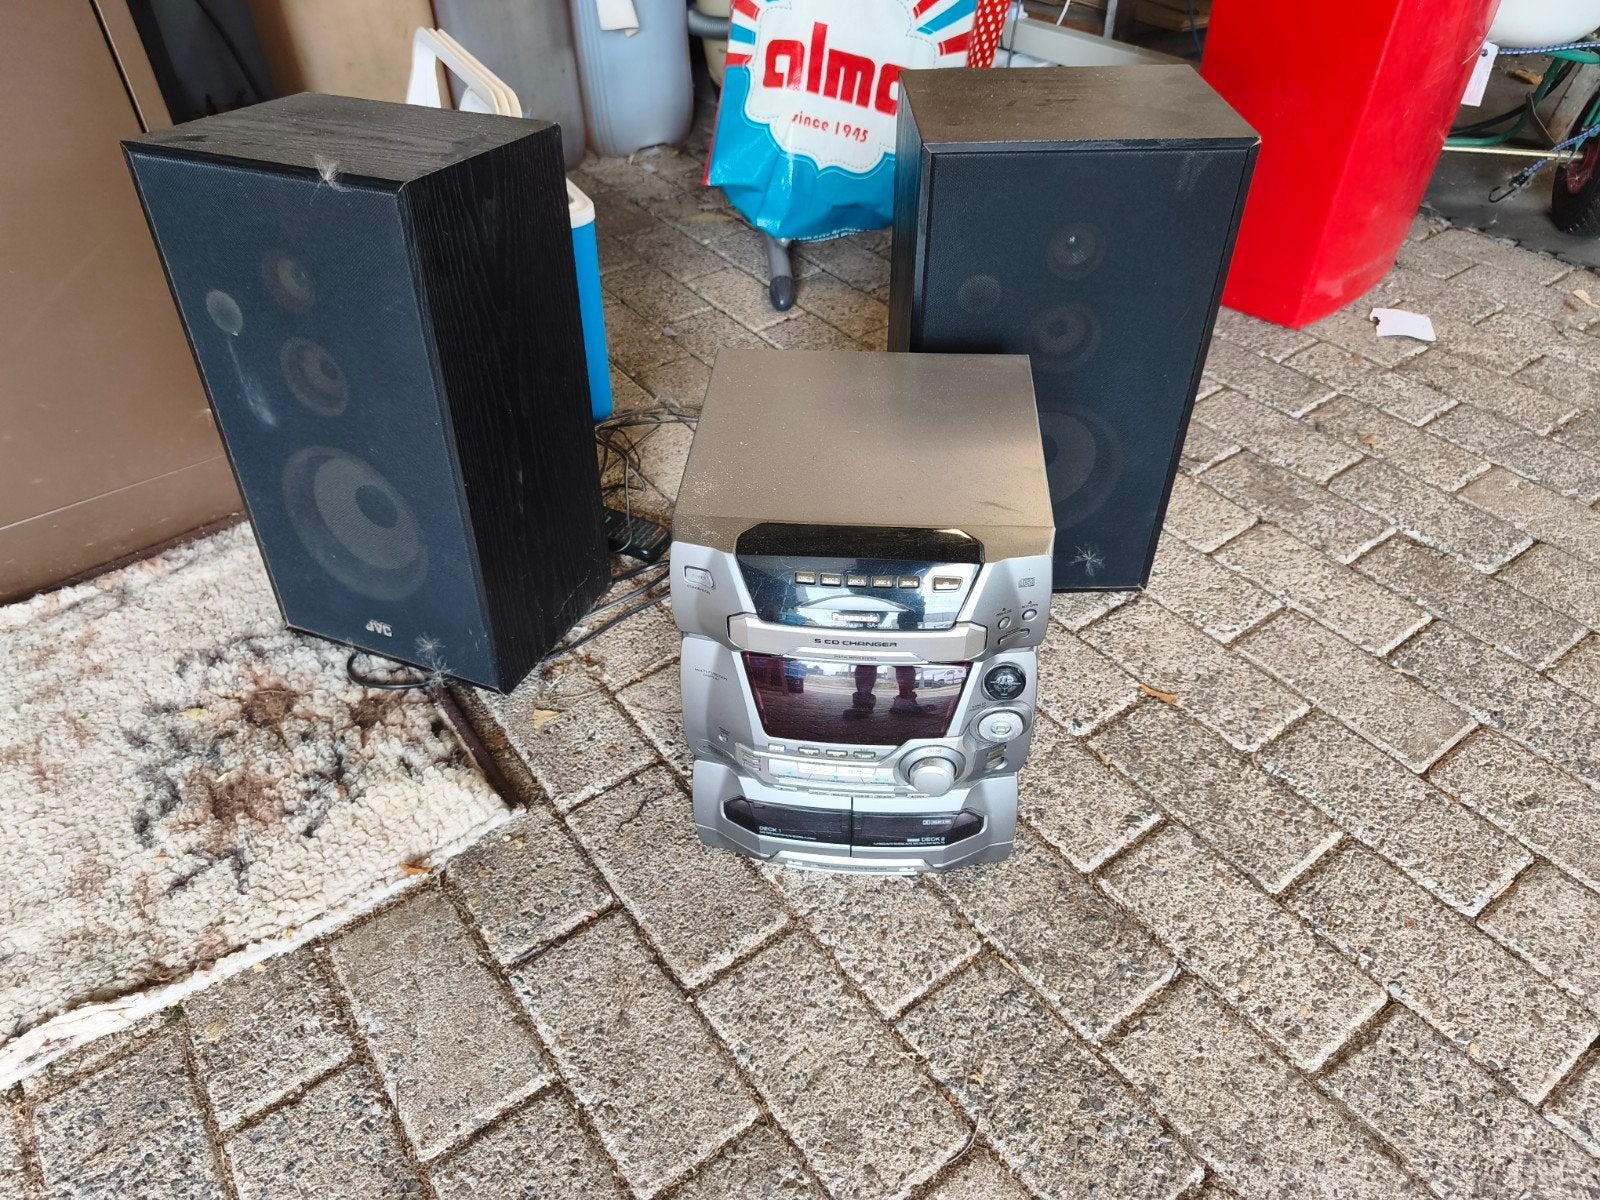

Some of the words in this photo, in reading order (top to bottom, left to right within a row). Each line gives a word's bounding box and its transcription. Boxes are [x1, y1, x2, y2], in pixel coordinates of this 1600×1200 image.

[792, 110, 829, 131] since
[835, 121, 868, 142] 1945
[366, 620, 392, 637] JVC
